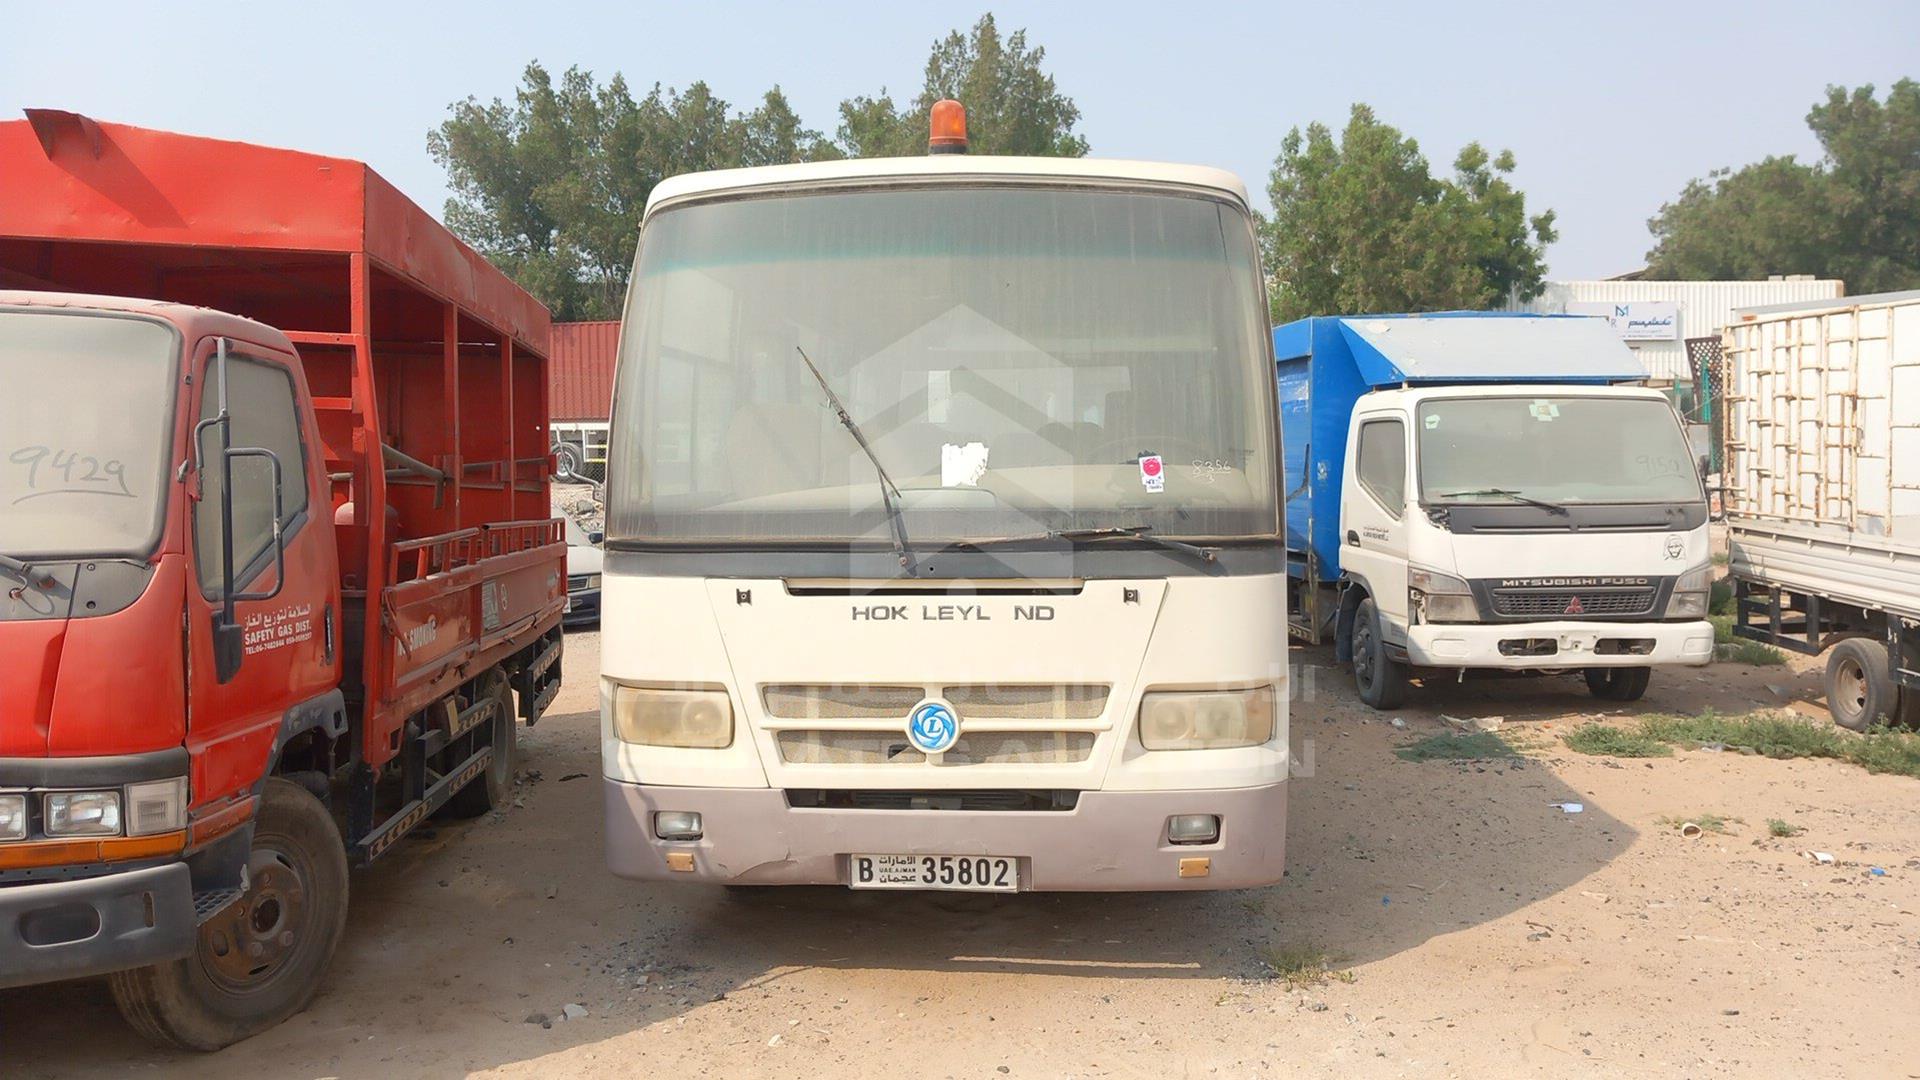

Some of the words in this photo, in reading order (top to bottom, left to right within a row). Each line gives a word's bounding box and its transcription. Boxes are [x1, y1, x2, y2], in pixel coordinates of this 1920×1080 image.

[9, 445, 130, 496] 9429
[1502, 578, 1597, 587] MITSUBISHI
[1601, 577, 1648, 585] FUSO
[244, 627, 275, 646] SAFETY
[277, 624, 293, 637] GAS
[295, 619, 312, 634] DIST.
[858, 857, 874, 883] B
[879, 874, 917, 884] عجمان
[922, 857, 1009, 887] 35802
